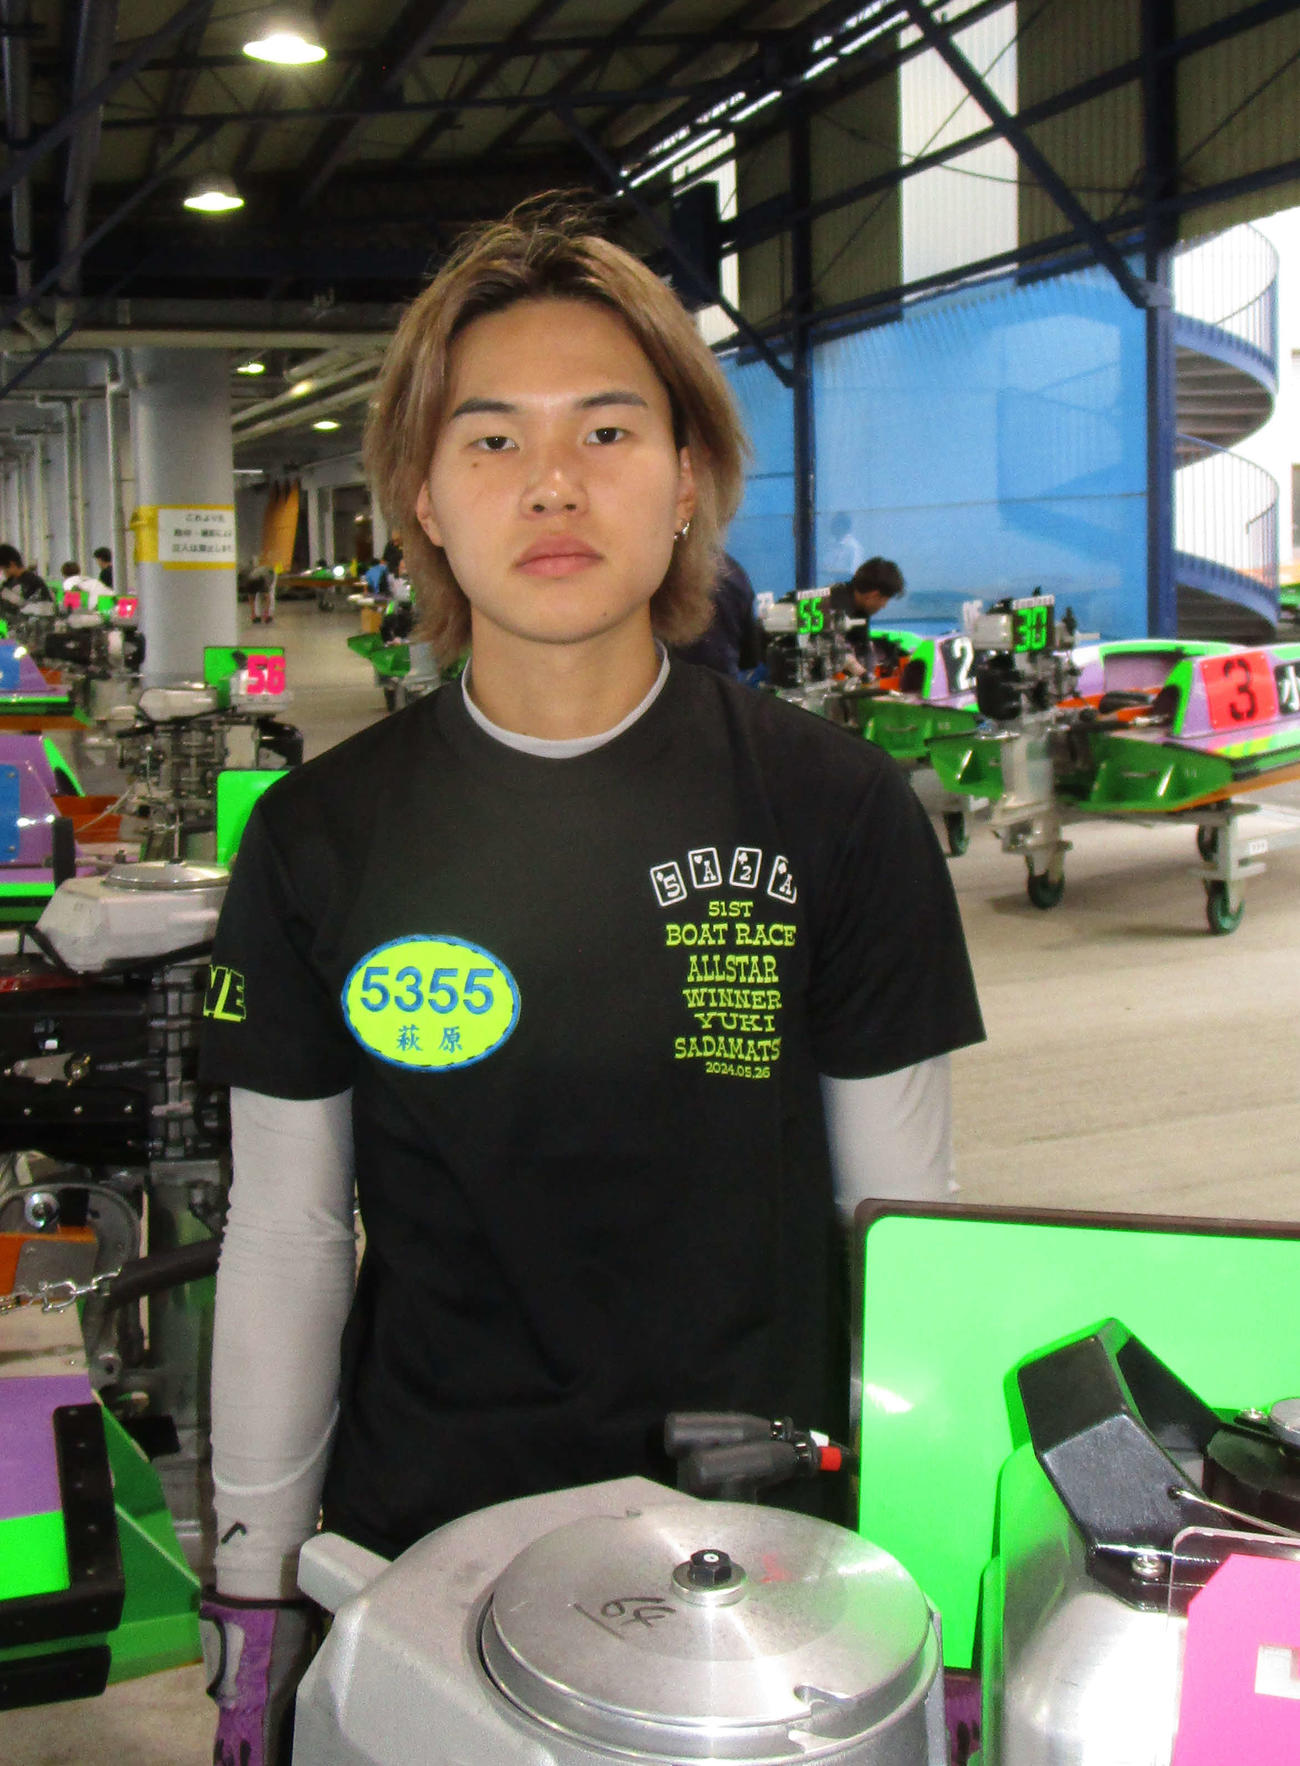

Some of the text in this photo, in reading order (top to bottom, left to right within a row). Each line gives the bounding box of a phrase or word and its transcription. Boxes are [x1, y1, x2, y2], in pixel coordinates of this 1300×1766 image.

[799, 596, 824, 634] 55
[1015, 605, 1048, 653] 30
[246, 654, 286, 695] 56
[953, 636, 977, 690] 2
[1223, 658, 1257, 721] 3
[703, 860, 716, 882] A
[740, 866, 752, 881] 2
[779, 874, 793, 895] A
[708, 900, 754, 918] 51ST
[665, 922, 797, 947] BOAT RACE
[686, 954, 780, 984] ALLSTAR
[360, 966, 495, 1015] 5355
[682, 987, 783, 1010] WINNER
[694, 1011, 776, 1033] YUKI
[396, 1025, 463, 1054] 萩原
[705, 1061, 771, 1079] 2024.05.26
